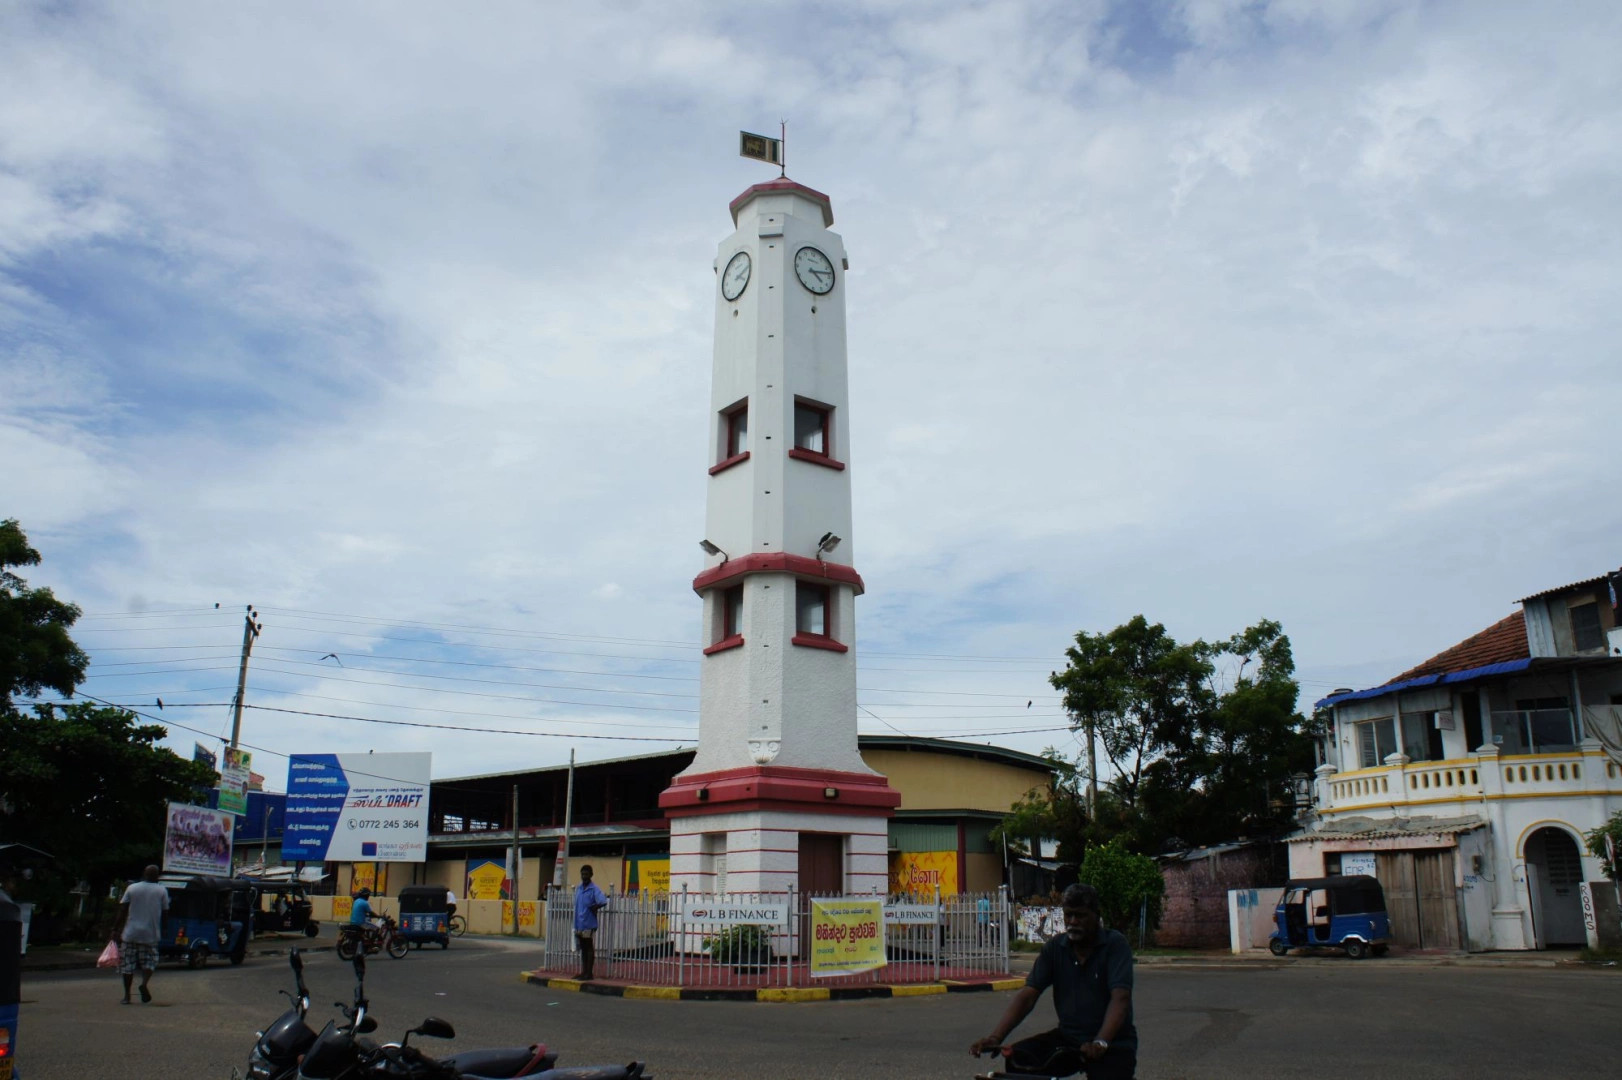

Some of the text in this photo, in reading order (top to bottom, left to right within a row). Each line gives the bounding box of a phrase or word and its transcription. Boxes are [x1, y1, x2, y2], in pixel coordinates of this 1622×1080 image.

[387, 794, 423, 808] DRAFT
[359, 820, 419, 829] 0772 245 364
[1580, 885, 1595, 931] ROOMS
[709, 909, 779, 920] L B FINANCE
[906, 911, 935, 919] FINANCE
